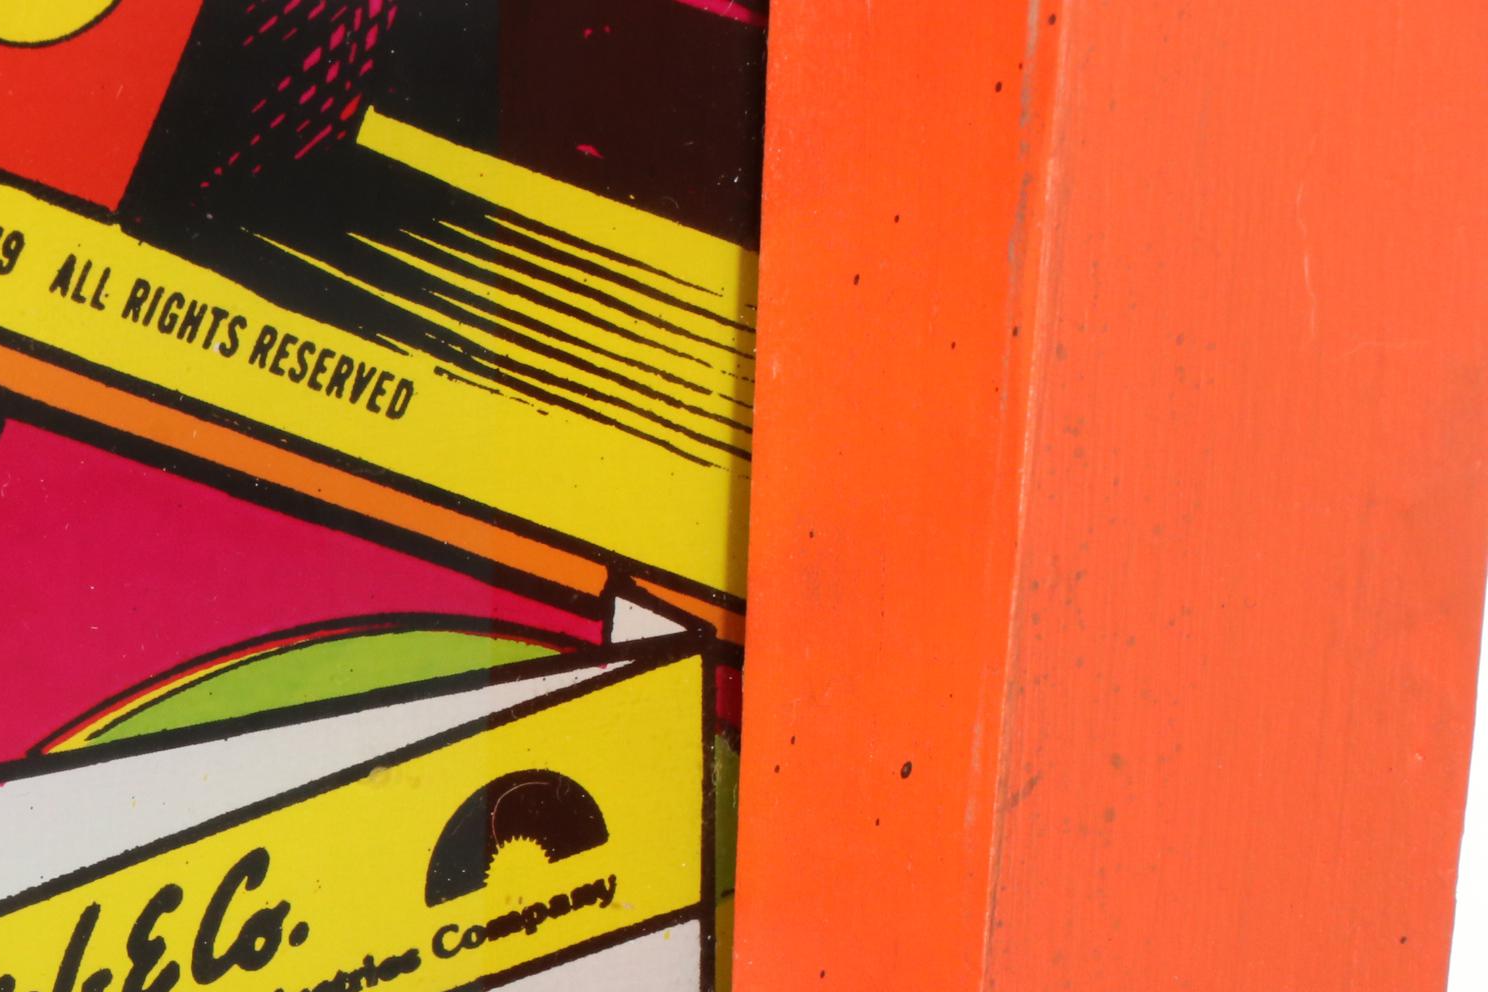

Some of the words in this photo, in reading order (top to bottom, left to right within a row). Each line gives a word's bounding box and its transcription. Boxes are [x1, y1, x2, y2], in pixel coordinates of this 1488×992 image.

[49, 253, 112, 310] ALL
[121, 278, 248, 358] RIGHTS
[248, 324, 415, 420] RESERVED
[191, 847, 310, 985] Co.
[431, 874, 617, 960] Company
